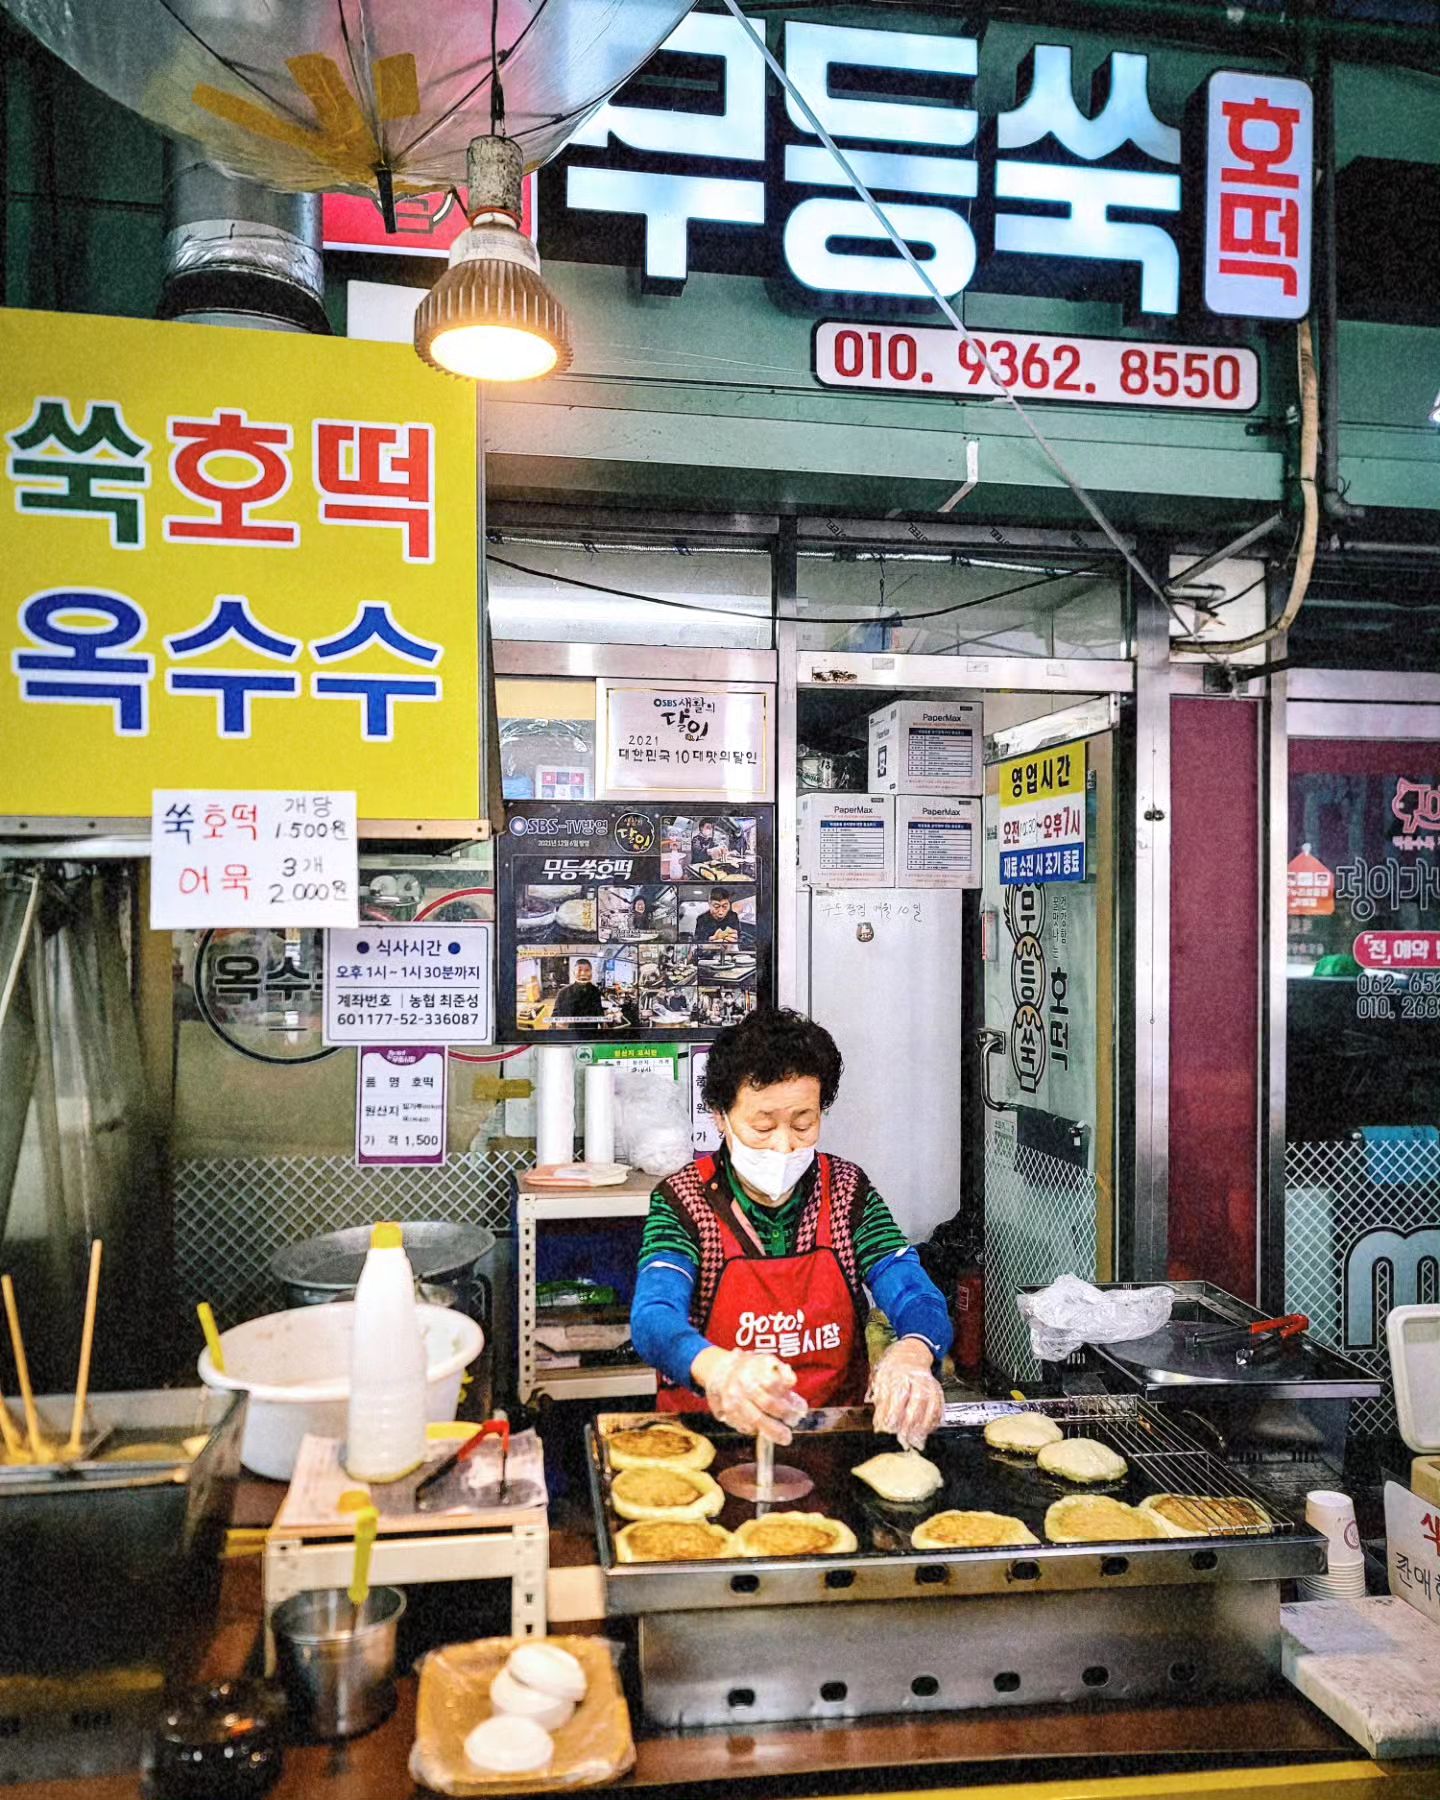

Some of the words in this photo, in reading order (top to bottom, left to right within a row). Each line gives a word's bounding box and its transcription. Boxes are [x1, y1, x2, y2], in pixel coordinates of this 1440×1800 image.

[565, 11, 1181, 315] 무등쑥
[1218, 97, 1300, 297] 호떡
[833, 331, 933, 385] 010.
[957, 336, 1096, 393] 9362.
[1120, 349, 1241, 401] 8550
[10, 400, 433, 560] 쑥호떡
[17, 591, 437, 736] 옥수수
[660, 708, 709, 742] 달인
[922, 713, 962, 722] PaperMax
[628, 735, 659, 746] 2021
[618, 748, 671, 764] 대한민국
[1011, 754, 1071, 798] 영업시간
[834, 806, 873, 814] PaperMax
[922, 808, 961, 816] PaperMax
[163, 803, 258, 845] 쑥호떡
[542, 859, 633, 880] 무등쑥호떡
[179, 863, 251, 900] 어묵
[376, 939, 442, 957] 식사시간
[214, 955, 323, 1002] 옥수
[336, 965, 363, 980] 오후
[424, 965, 480, 980] 30분까지
[337, 993, 392, 1009] 계좌번호
[409, 993, 435, 1009] 농협
[440, 993, 478, 1009] 최준성
[337, 1013, 479, 1025] 601177-52-336087
[1050, 966, 1069, 1071] 호떡
[411, 1076, 434, 1088] 호떡
[365, 1105, 399, 1117] 원산지
[405, 1135, 439, 1147] 1,500
